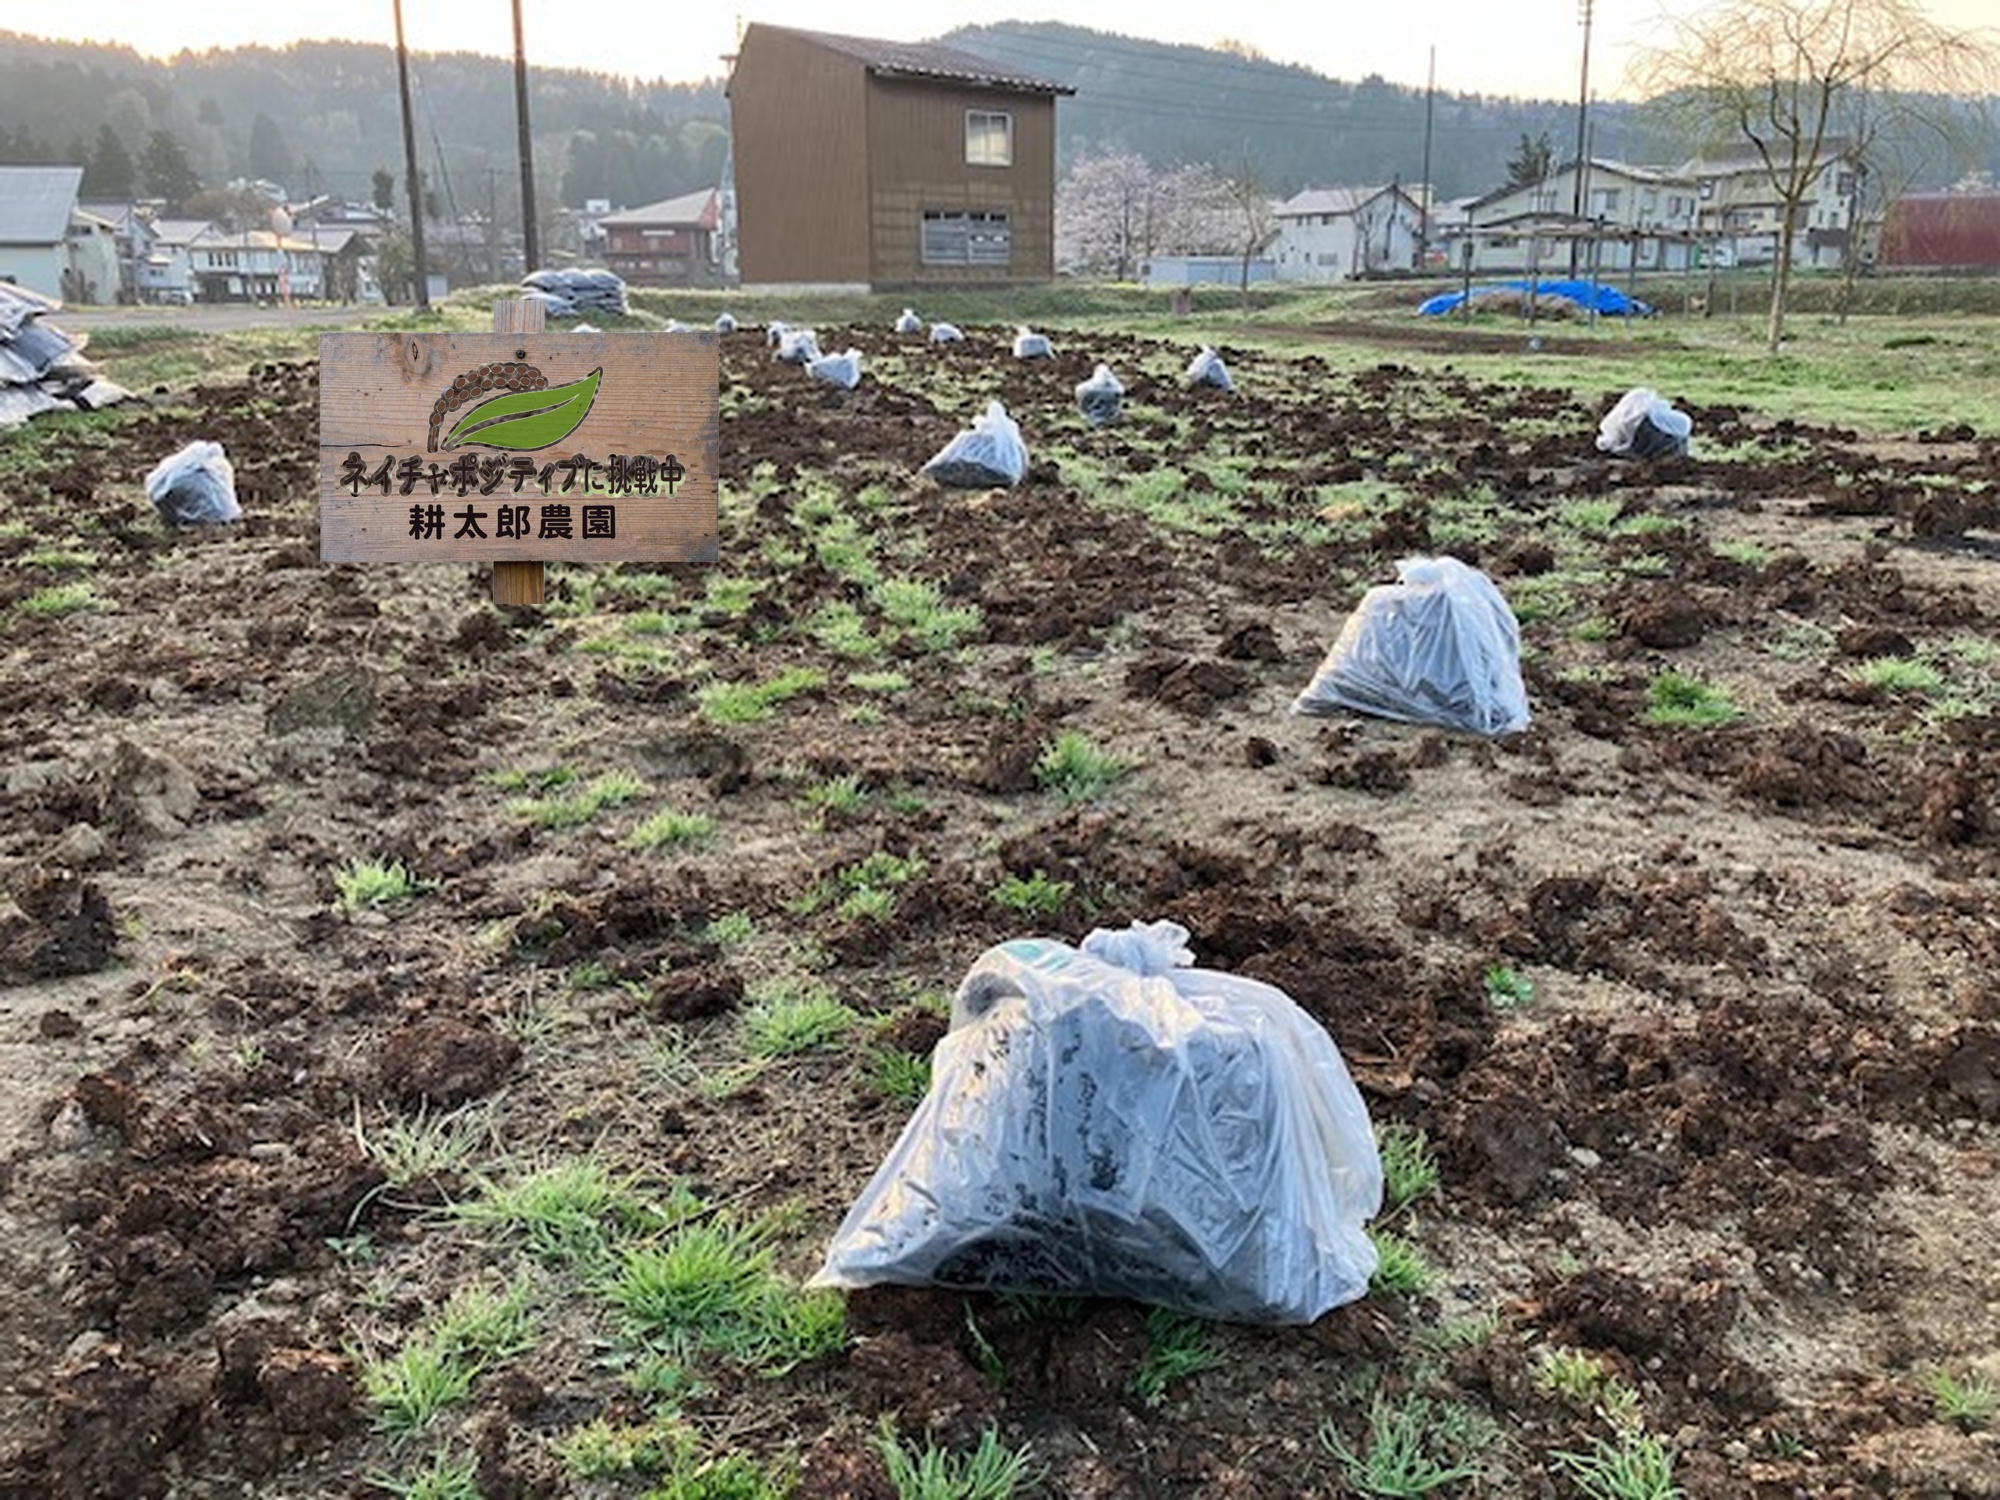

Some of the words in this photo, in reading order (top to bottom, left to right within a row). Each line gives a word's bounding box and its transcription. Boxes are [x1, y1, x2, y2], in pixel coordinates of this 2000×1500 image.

[341, 453, 684, 496] ネイチャポジティブに挑戦中
[408, 504, 616, 540] 耕太郎農園
